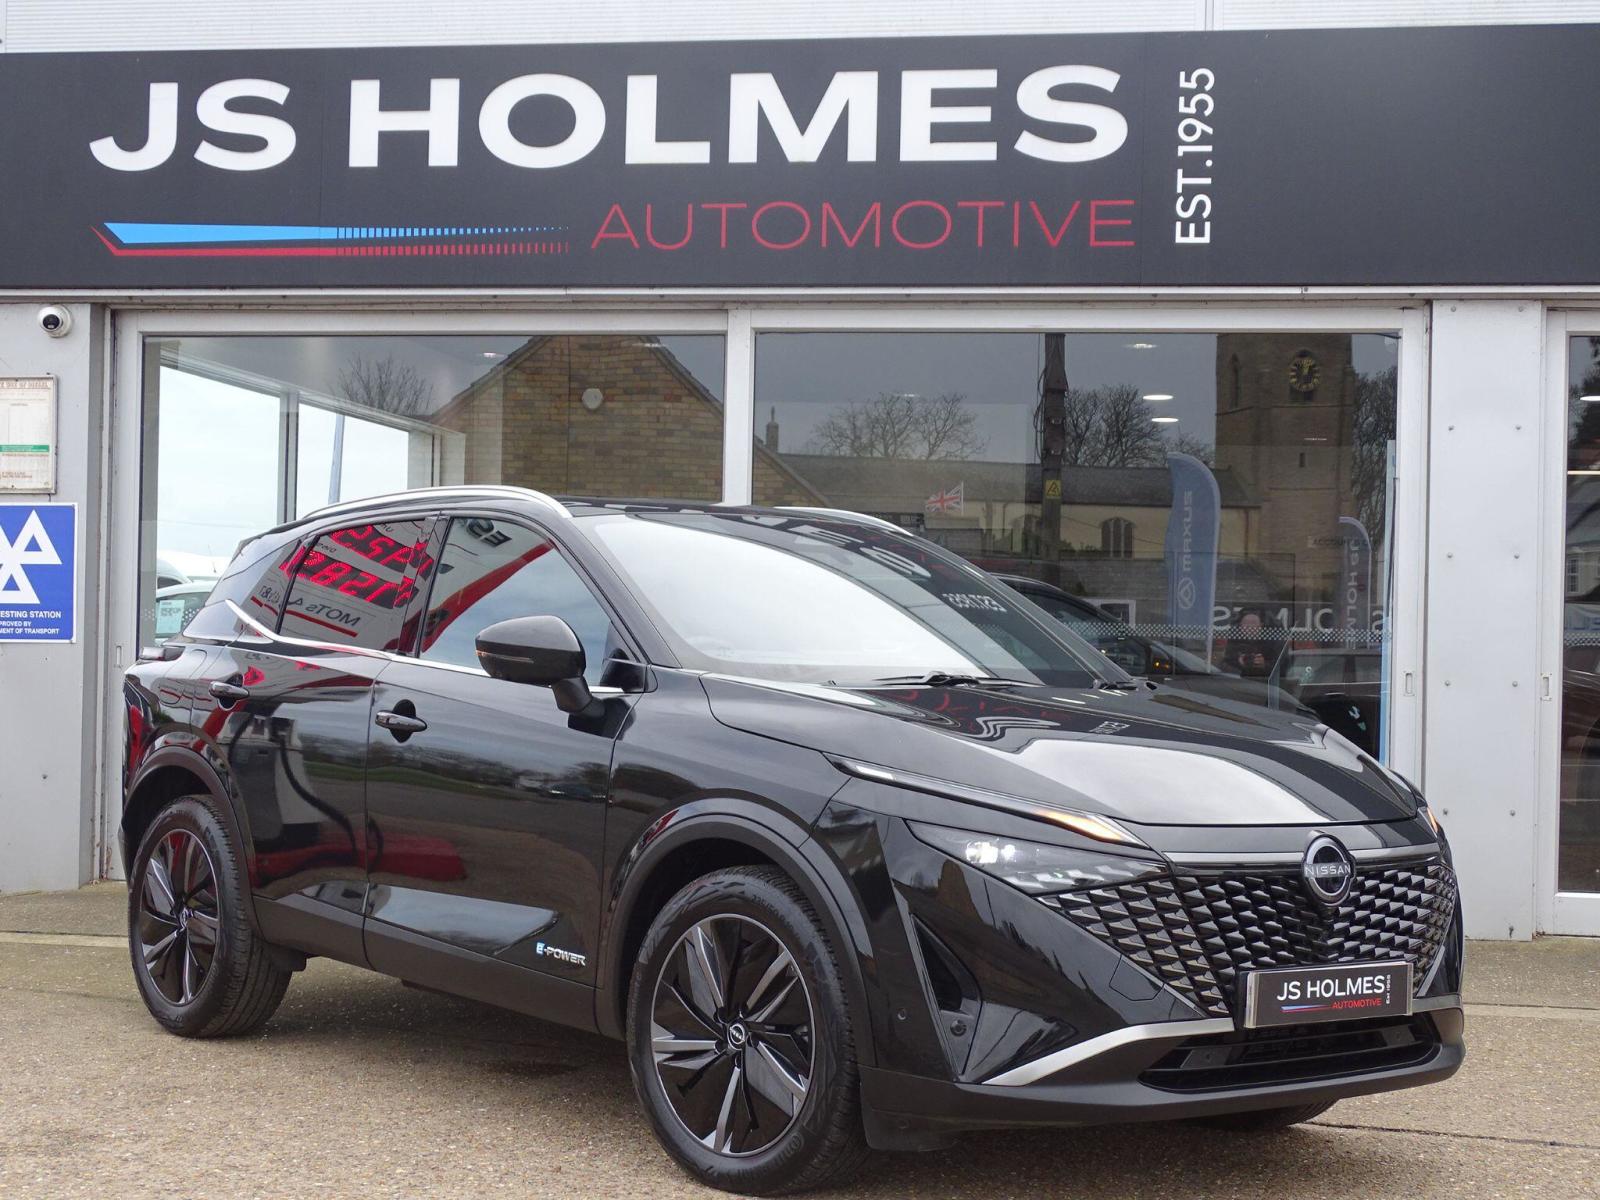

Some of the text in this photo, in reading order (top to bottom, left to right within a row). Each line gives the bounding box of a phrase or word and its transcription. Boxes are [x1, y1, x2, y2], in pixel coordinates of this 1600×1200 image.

[89, 65, 1129, 171] JS HOLMES
[1174, 67, 1215, 245] EST.1955
[591, 199, 1136, 250] AUTOMOTIVE
[30, 610, 62, 618] STATION
[1304, 864, 1351, 875] NISSAN
[1277, 981, 1301, 1001] JS
[1306, 975, 1386, 999] HOLMES
[1331, 997, 1383, 1010] AUTOMOTIVE
